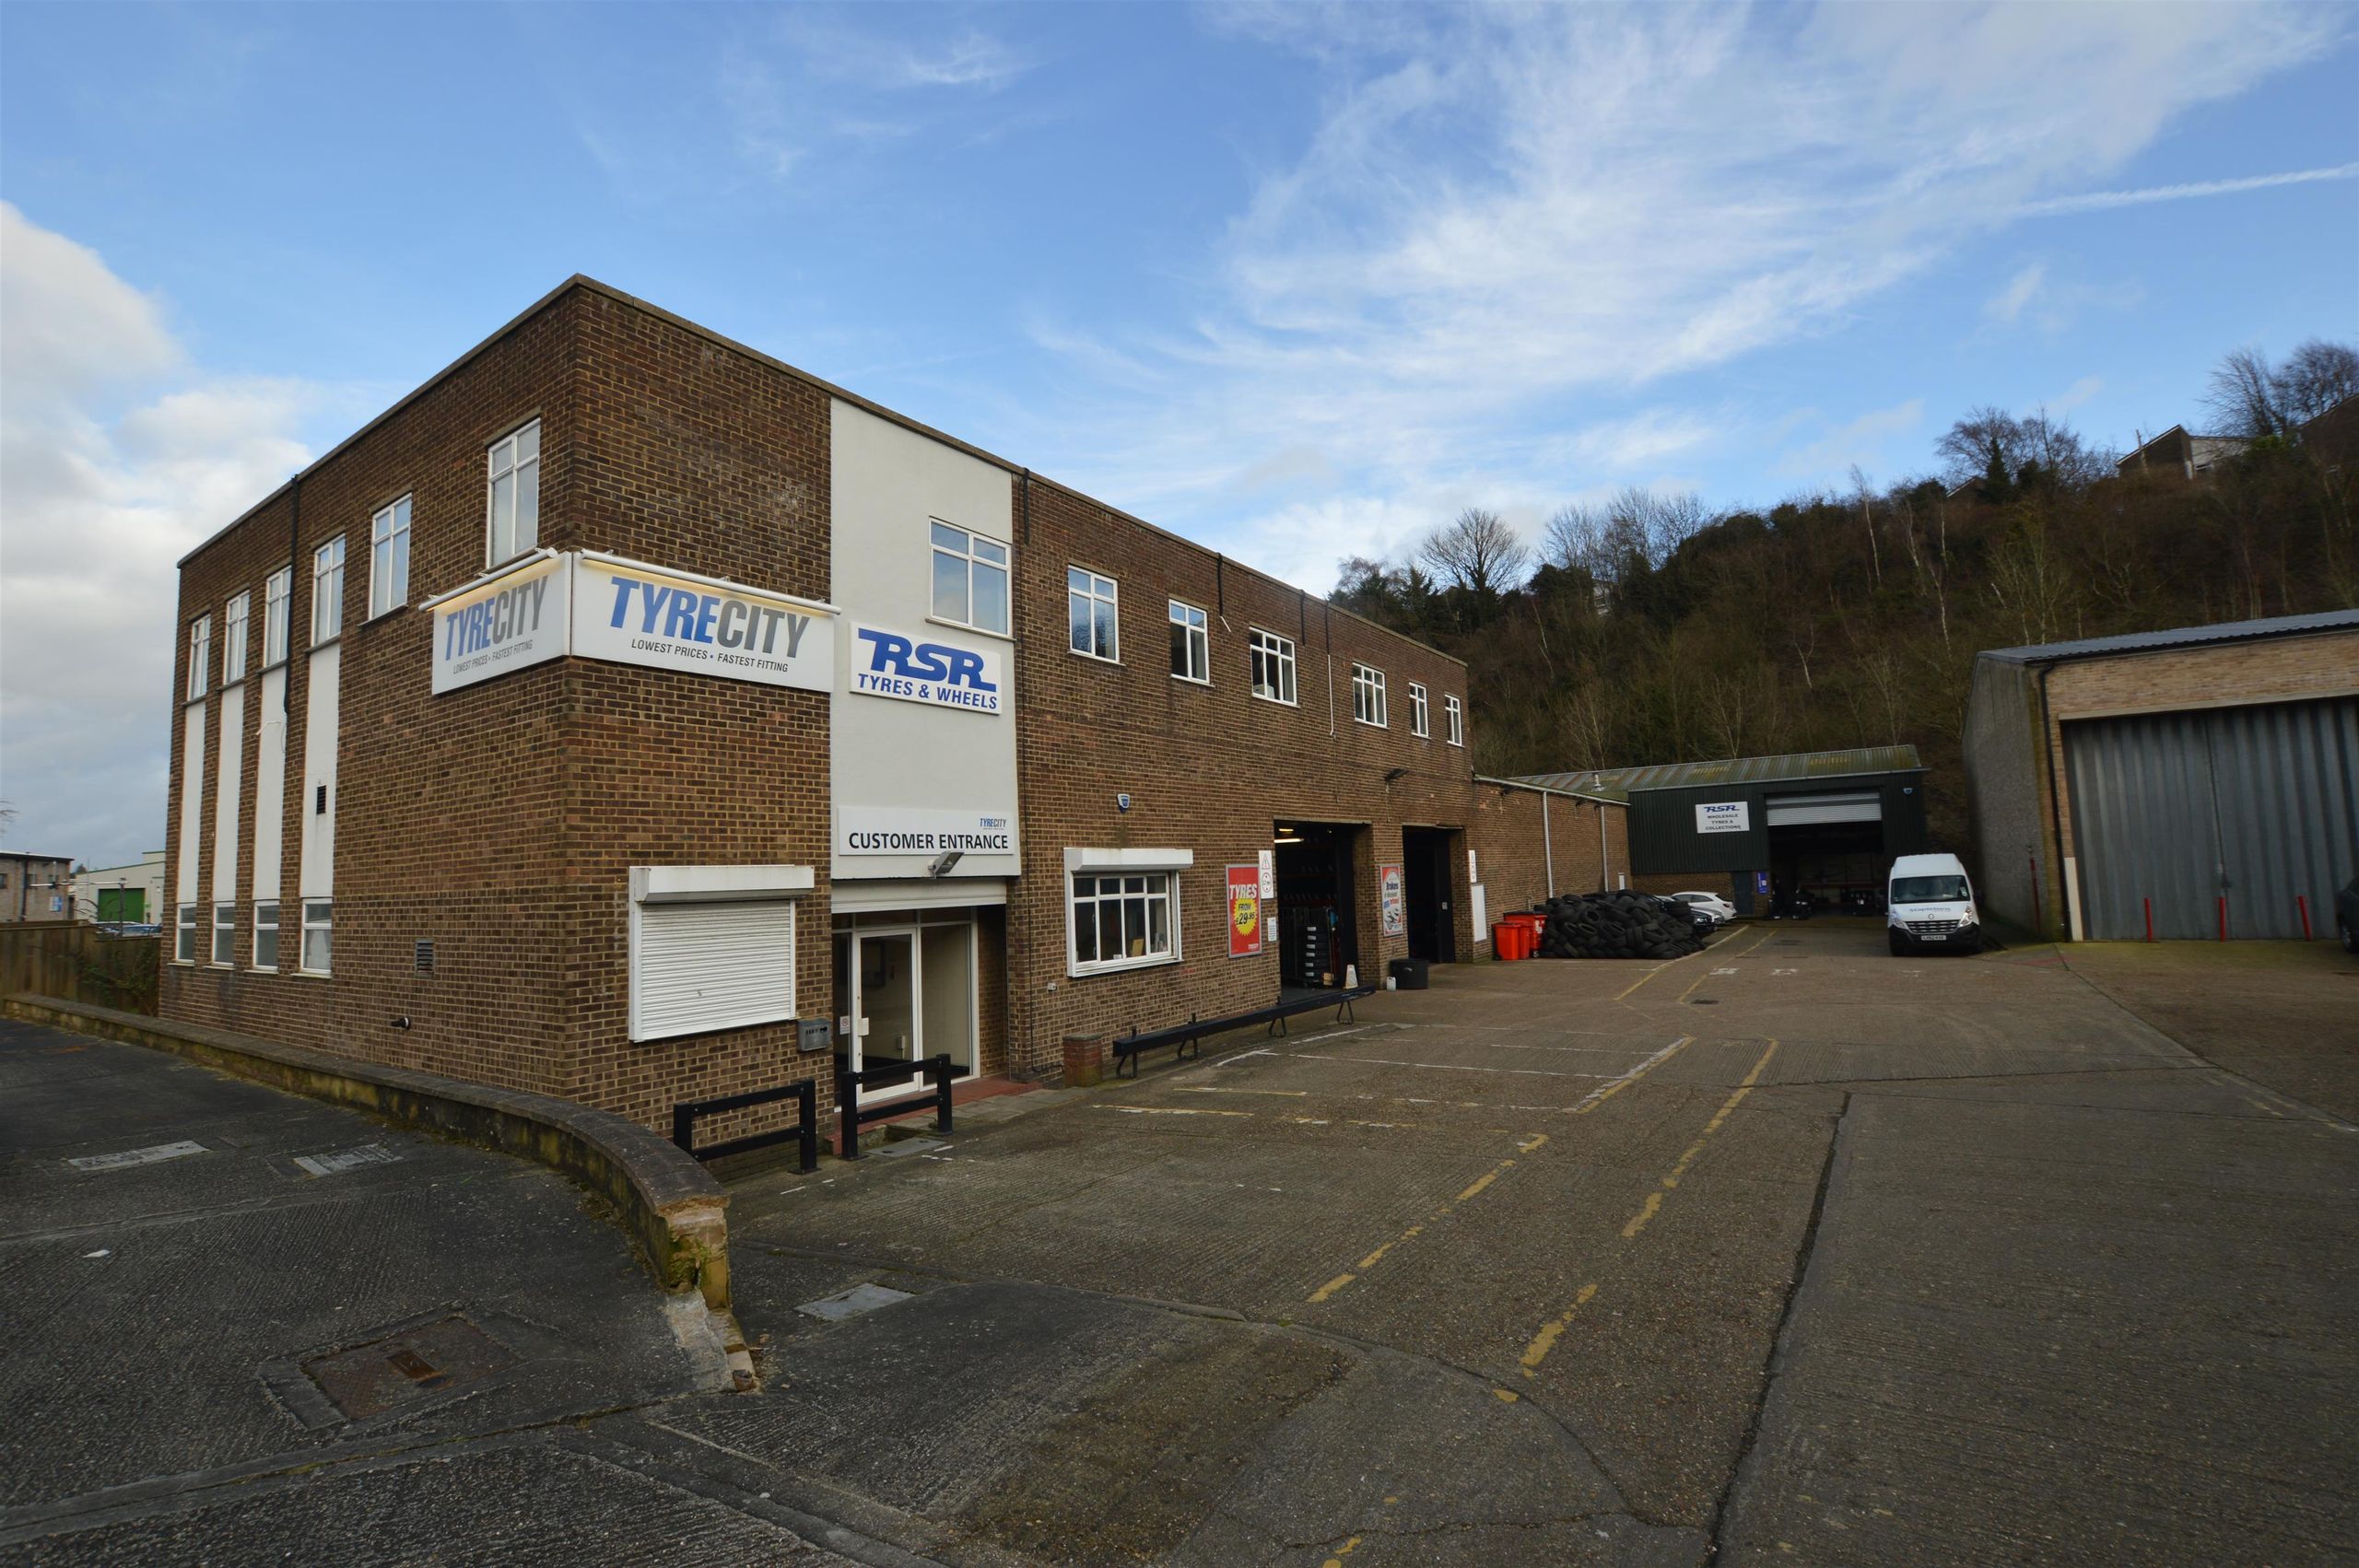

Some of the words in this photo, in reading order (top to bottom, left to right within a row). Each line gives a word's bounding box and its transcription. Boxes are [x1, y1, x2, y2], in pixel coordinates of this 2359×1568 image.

[445, 575, 548, 661] TYRECITY
[610, 576, 810, 658] TYRECITY
[452, 660, 472, 674] LOWEST
[471, 654, 488, 669] PRICES
[491, 646, 513, 661] FASTEST
[513, 639, 534, 654] FITTING
[631, 638, 673, 655] LOWEST
[675, 645, 709, 660] PRICES
[717, 652, 757, 668] FASTEST
[757, 659, 789, 673] FITTING
[858, 627, 996, 693] RSR
[858, 673, 913, 696] TYRES
[918, 684, 930, 698] &
[937, 686, 997, 709] WHEELS
[980, 818, 1006, 827] TYRECITY
[849, 833, 934, 849] CUSTOMER
[939, 834, 1008, 849] ENTRANCE
[1229, 884, 1258, 899] TYRES
[1238, 903, 1252, 911] FROM
